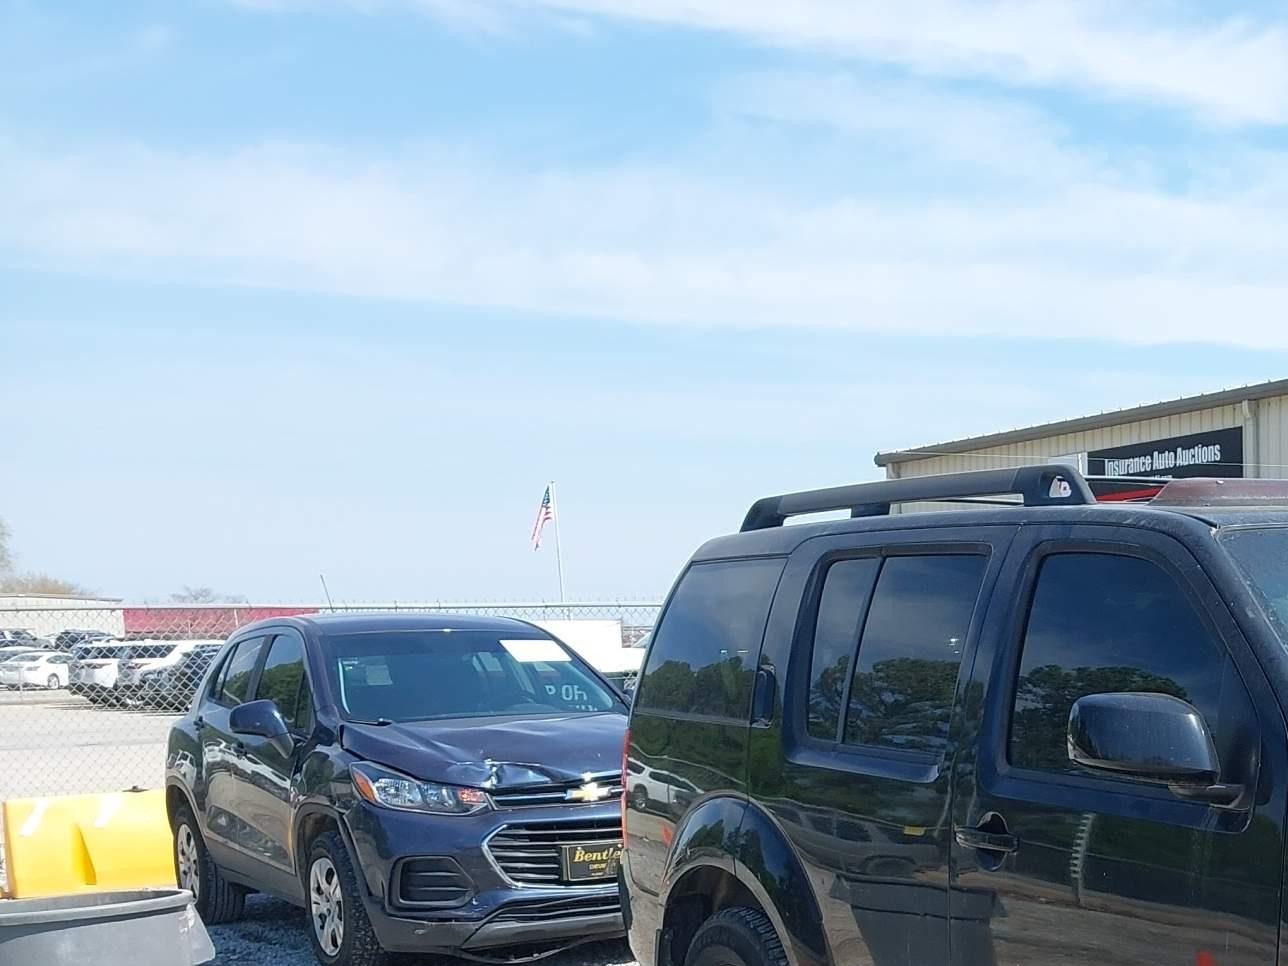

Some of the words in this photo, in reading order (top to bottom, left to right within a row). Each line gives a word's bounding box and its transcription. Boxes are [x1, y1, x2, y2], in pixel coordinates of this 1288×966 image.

[1104, 455, 1152, 477] Insurance
[1152, 450, 1175, 470] Auto
[1176, 444, 1221, 466] Auctions
[573, 846, 624, 862] Bentle
